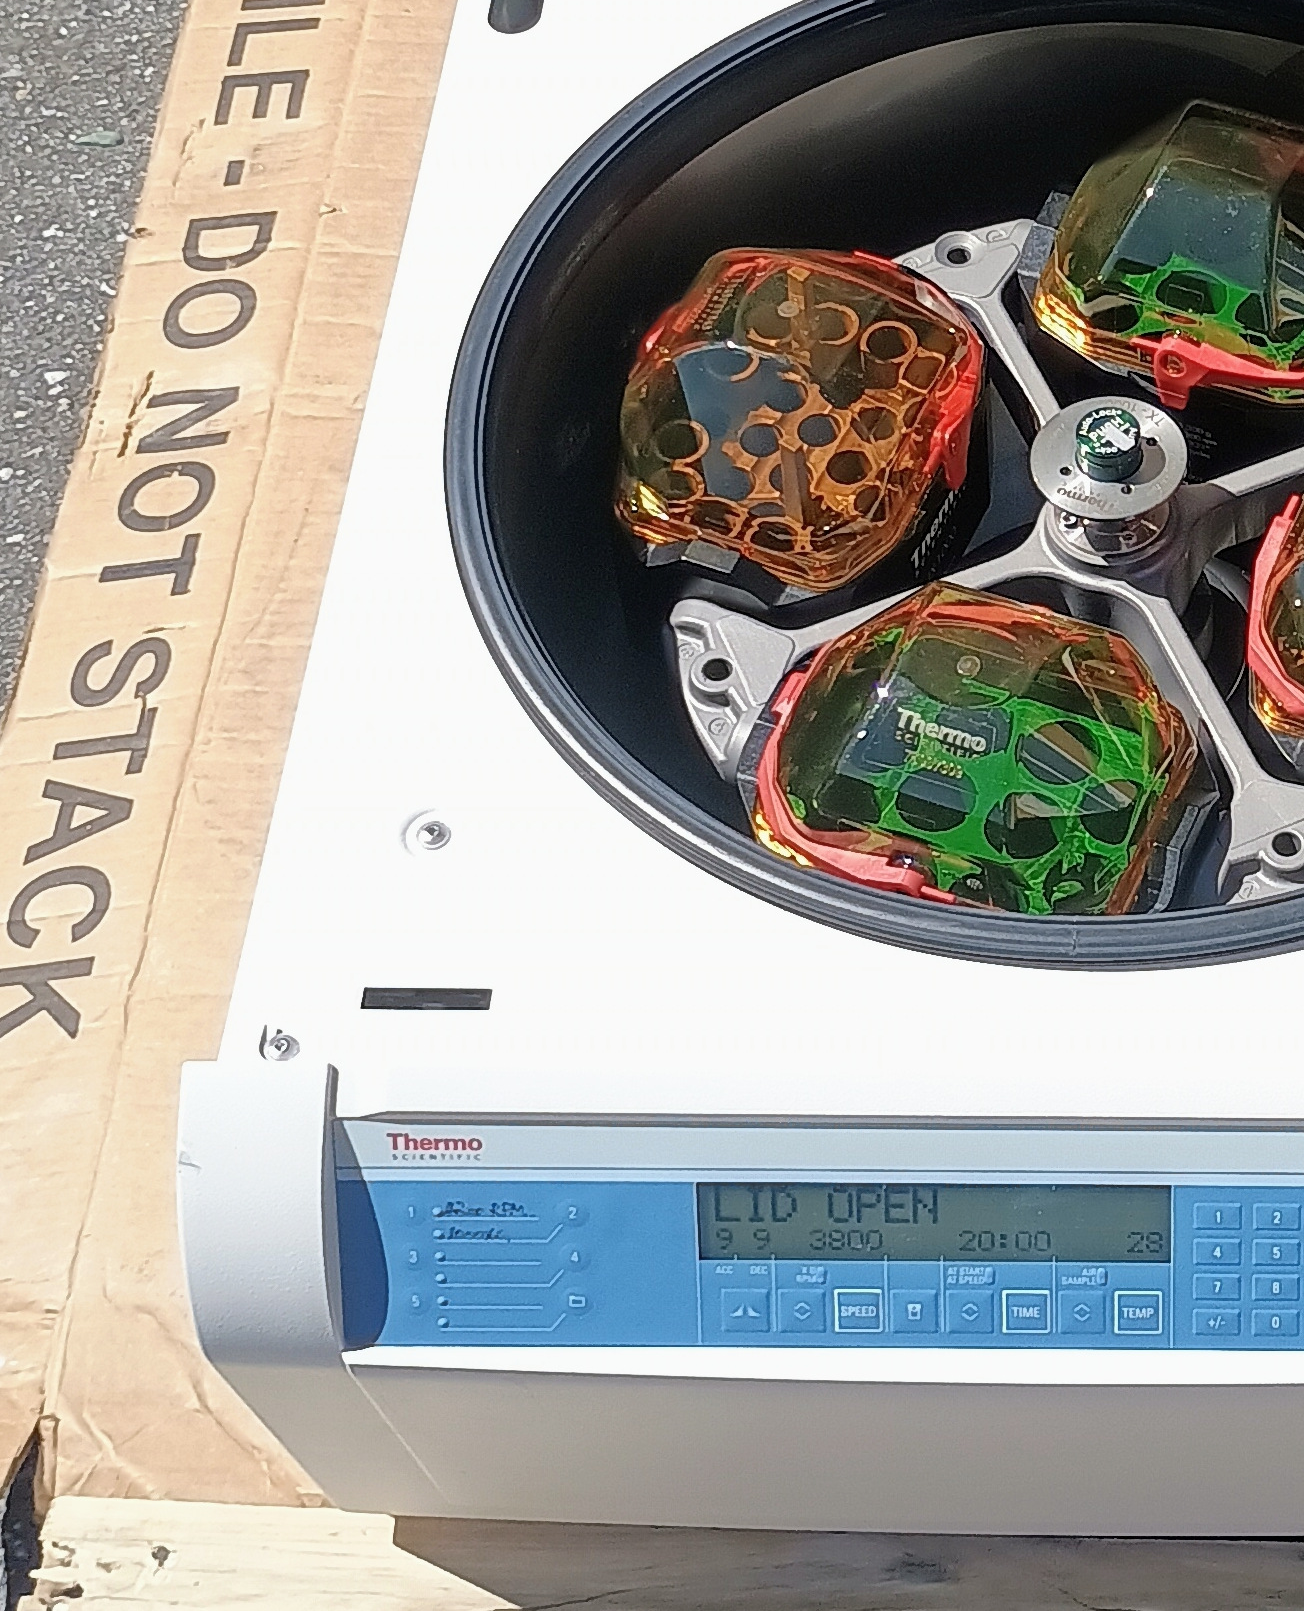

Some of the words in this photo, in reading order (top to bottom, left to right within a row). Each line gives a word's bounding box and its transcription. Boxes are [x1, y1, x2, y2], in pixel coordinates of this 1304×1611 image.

[162, 210, 278, 350] DO
[98, 385, 241, 597] NOT
[910, 490, 960, 569] Therm
[897, 706, 987, 752] Thermo
[0, 636, 173, 1039] STACK
[386, 1132, 483, 1152] Thermo
[391, 1153, 481, 1162] SCIENTIFIC
[408, 1206, 415, 1219] 1
[714, 1187, 798, 1223] LID
[828, 1187, 938, 1224] OPEN
[568, 1207, 578, 1220] 2
[1214, 1210, 1221, 1224] 1
[1272, 1211, 1282, 1225] 2
[808, 1229, 884, 1252] 3800
[958, 1230, 1051, 1253] 20:00
[408, 1250, 418, 1264] 3
[570, 1250, 579, 1263] 4
[1212, 1246, 1222, 1259] 4
[1271, 1246, 1281, 1259] 5
[1213, 1281, 1221, 1293] 7
[1271, 1281, 1280, 1295] 8
[411, 1293, 420, 1308] 5
[840, 1305, 877, 1317] SPEED
[1011, 1306, 1041, 1318] TIME
[1122, 1307, 1155, 1319] TEMP
[1207, 1315, 1226, 1330] +/-
[1271, 1315, 1280, 1329] 0
